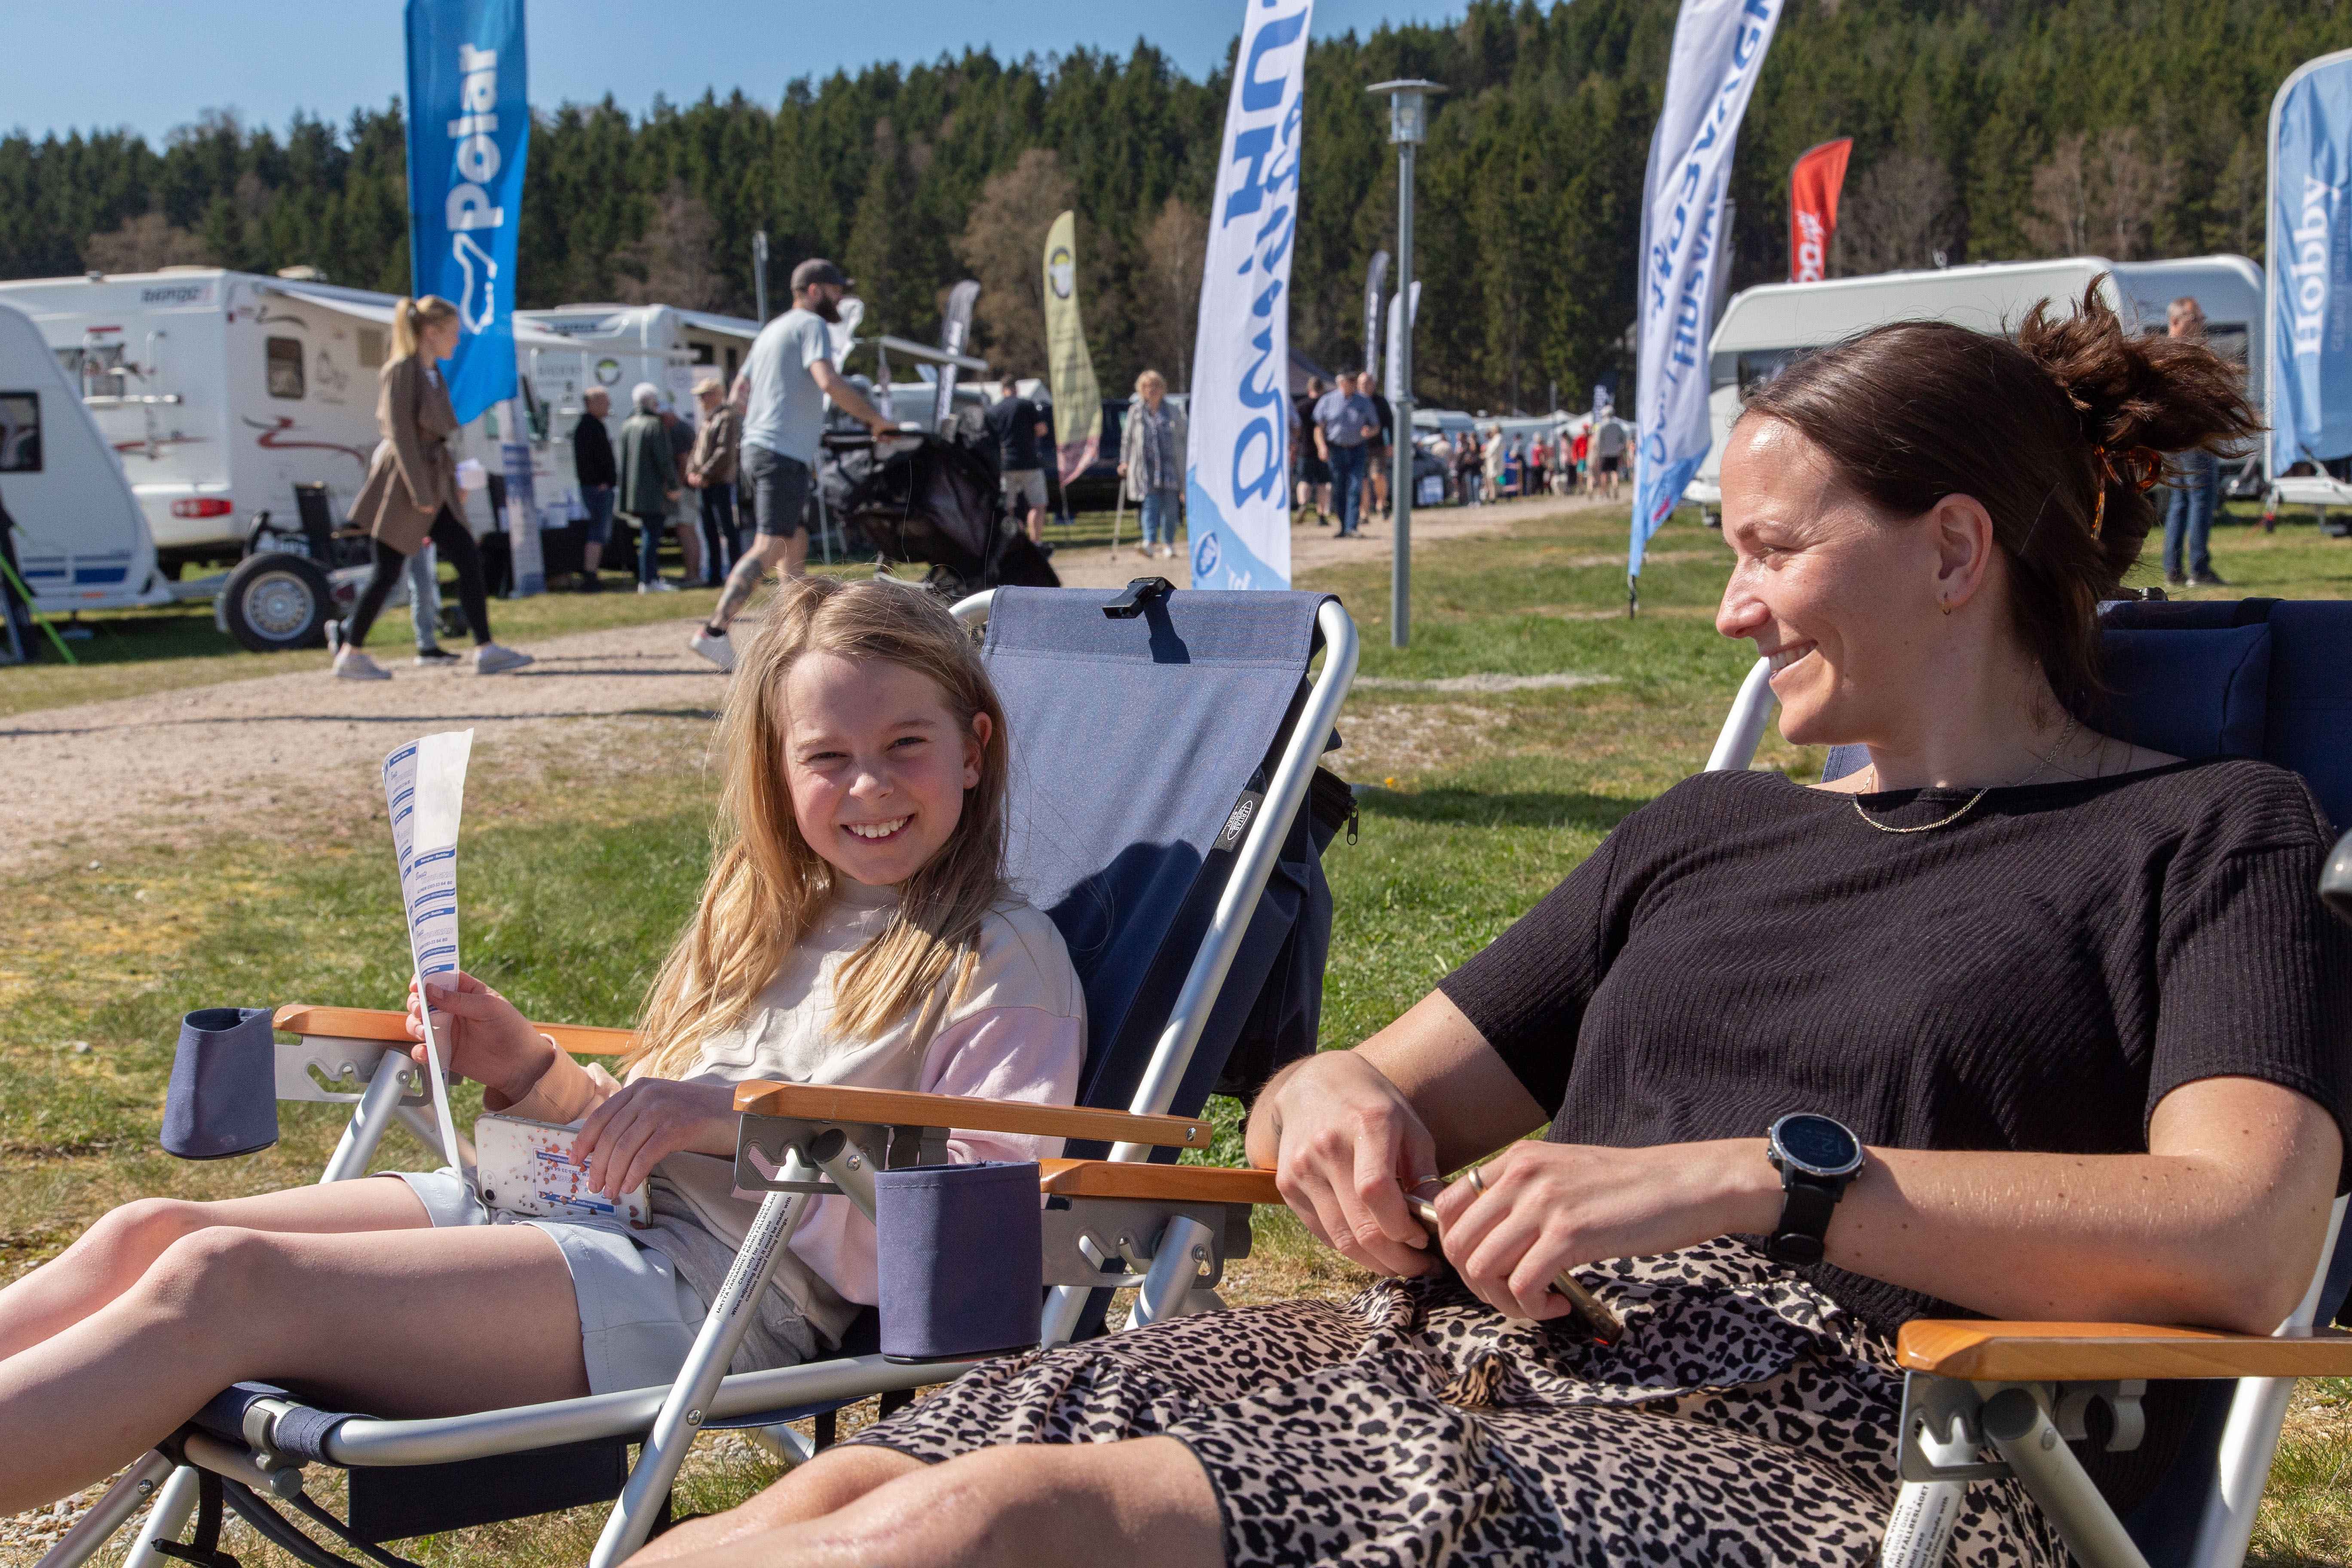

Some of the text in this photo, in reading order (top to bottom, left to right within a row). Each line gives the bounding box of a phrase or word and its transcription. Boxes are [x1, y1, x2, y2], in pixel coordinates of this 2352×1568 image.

[445, 43, 503, 231] Polar
[2290, 175, 2341, 357] Hobby
[716, 1291, 729, 1314] IAKTTA
[728, 1254, 747, 1290] VARSAMHET
[746, 1234, 757, 1253] KRING
[730, 1298, 742, 1317] -When
[739, 1271, 756, 1299] adjusting
[752, 1255, 764, 1271] back;
[764, 1234, 773, 1250] must
[775, 1209, 786, 1225] made
[783, 1196, 792, 1209] with
[737, 1268, 748, 1286] -Chair
[745, 1256, 755, 1269] only
[756, 1231, 766, 1246] adult
[744, 1216, 789, 1302] caution around folding fittings.
